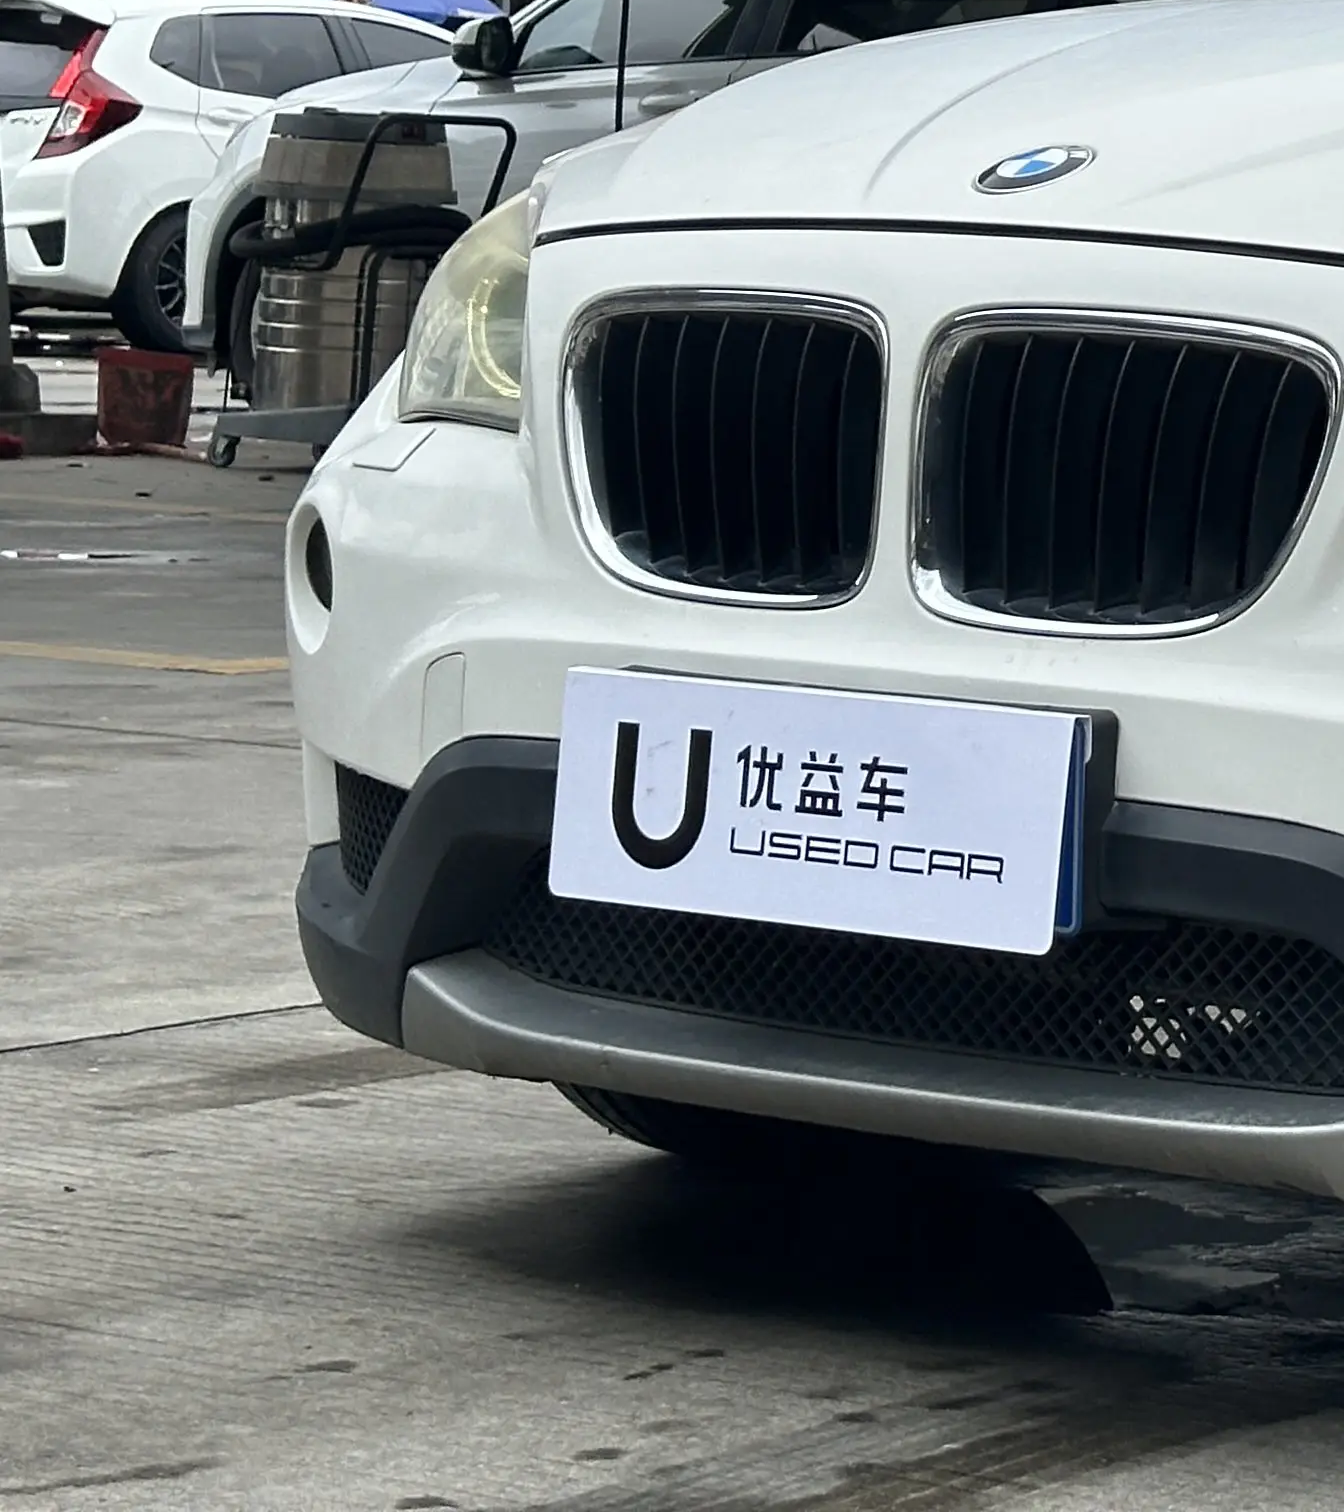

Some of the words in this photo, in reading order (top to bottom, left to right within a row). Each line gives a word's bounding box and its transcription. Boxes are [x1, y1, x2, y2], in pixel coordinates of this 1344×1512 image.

[611, 721, 713, 870] U
[737, 744, 909, 822] 优益车
[730, 827, 879, 869] USED
[890, 845, 1004, 884] CAR
